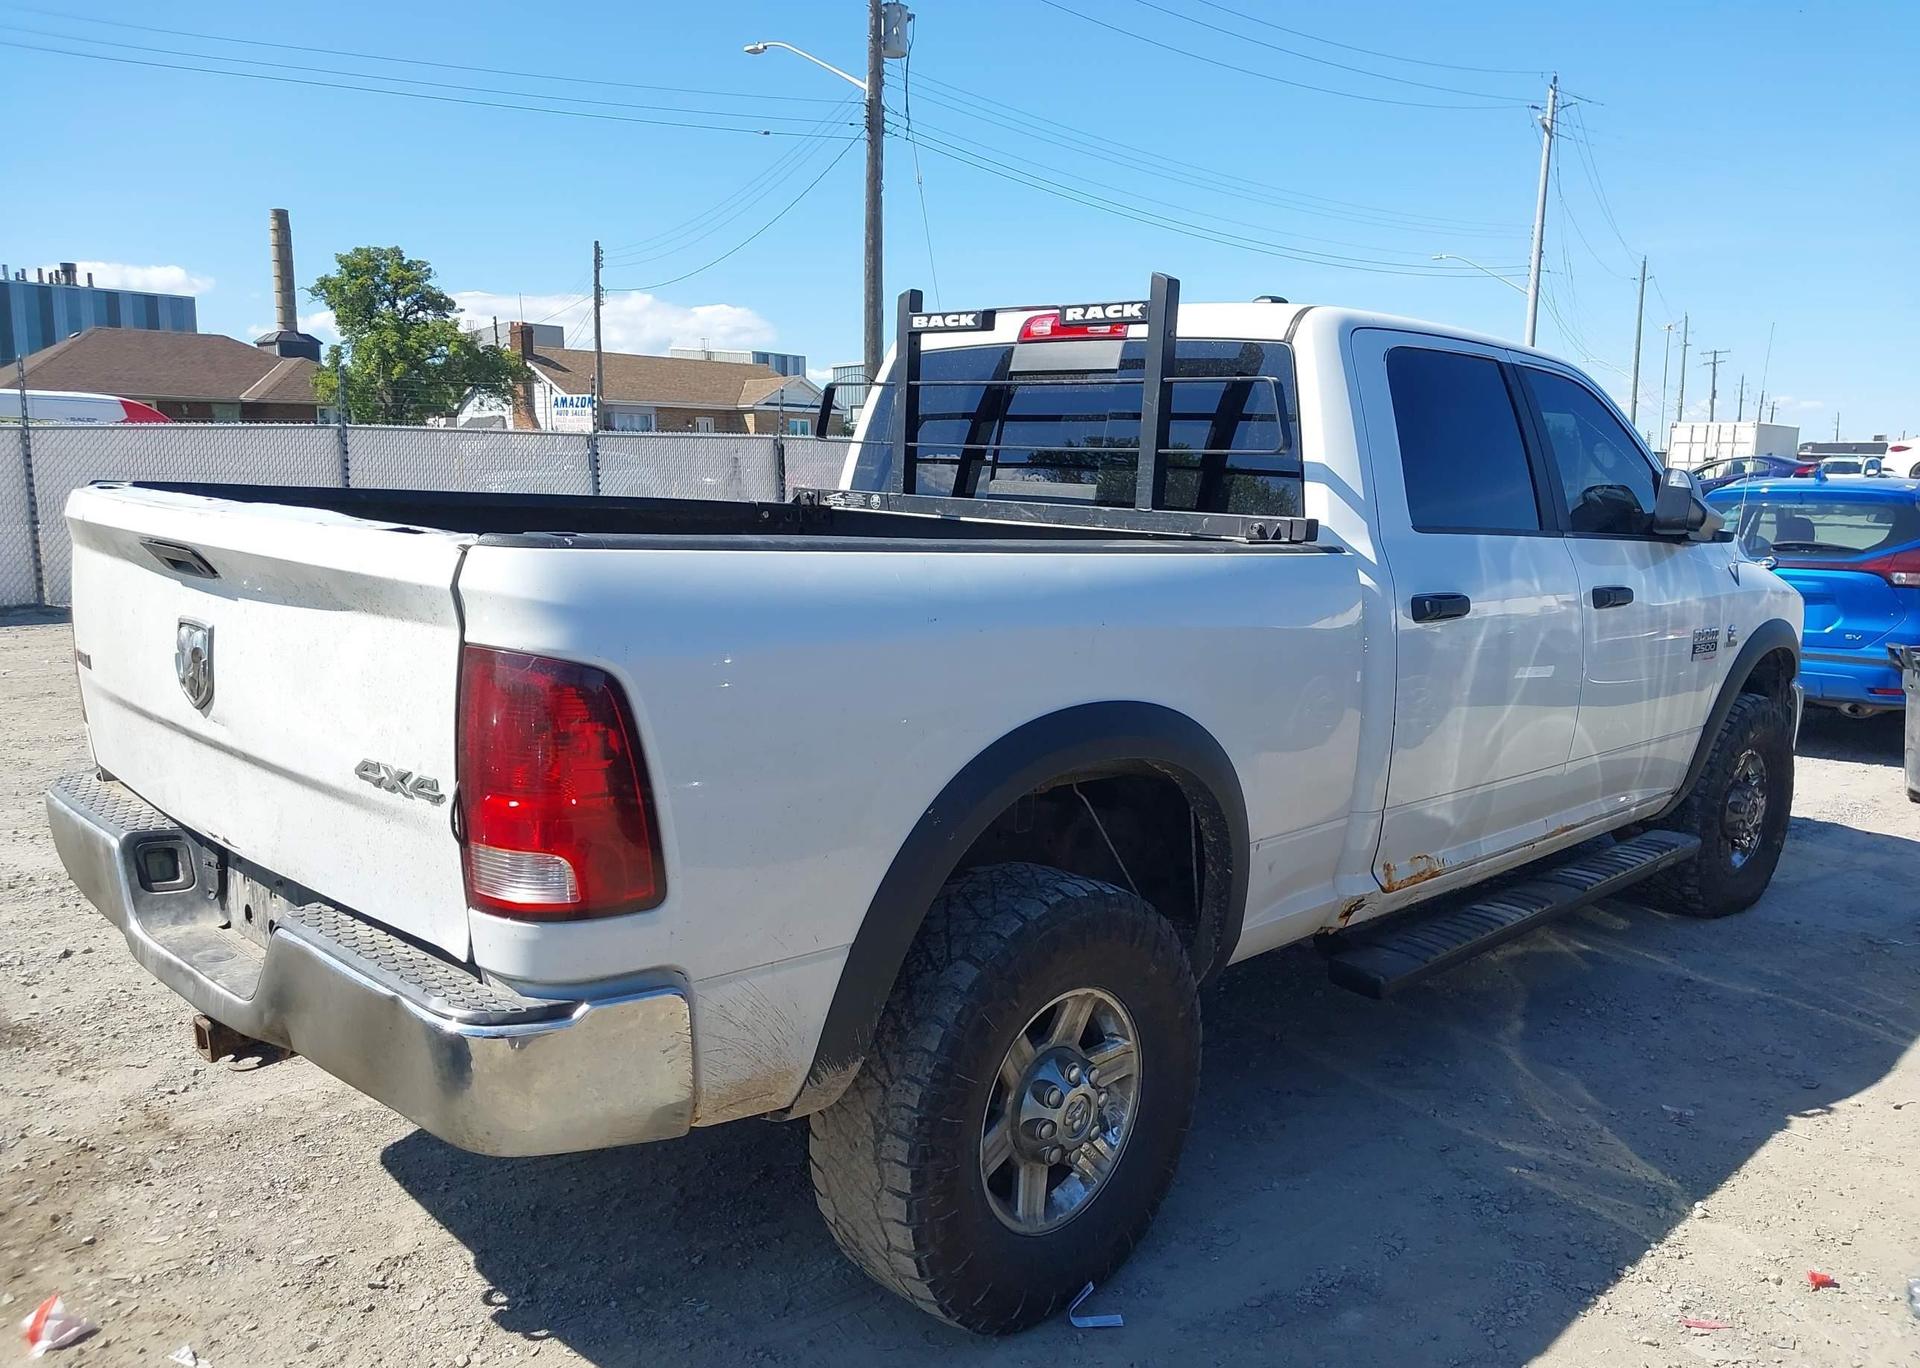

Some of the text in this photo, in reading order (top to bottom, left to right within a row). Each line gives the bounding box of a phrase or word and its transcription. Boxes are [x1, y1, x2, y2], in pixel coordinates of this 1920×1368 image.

[912, 303, 1143, 328] BACK RACK
[553, 396, 593, 408] AMAZON
[1695, 643, 1716, 653] 2500
